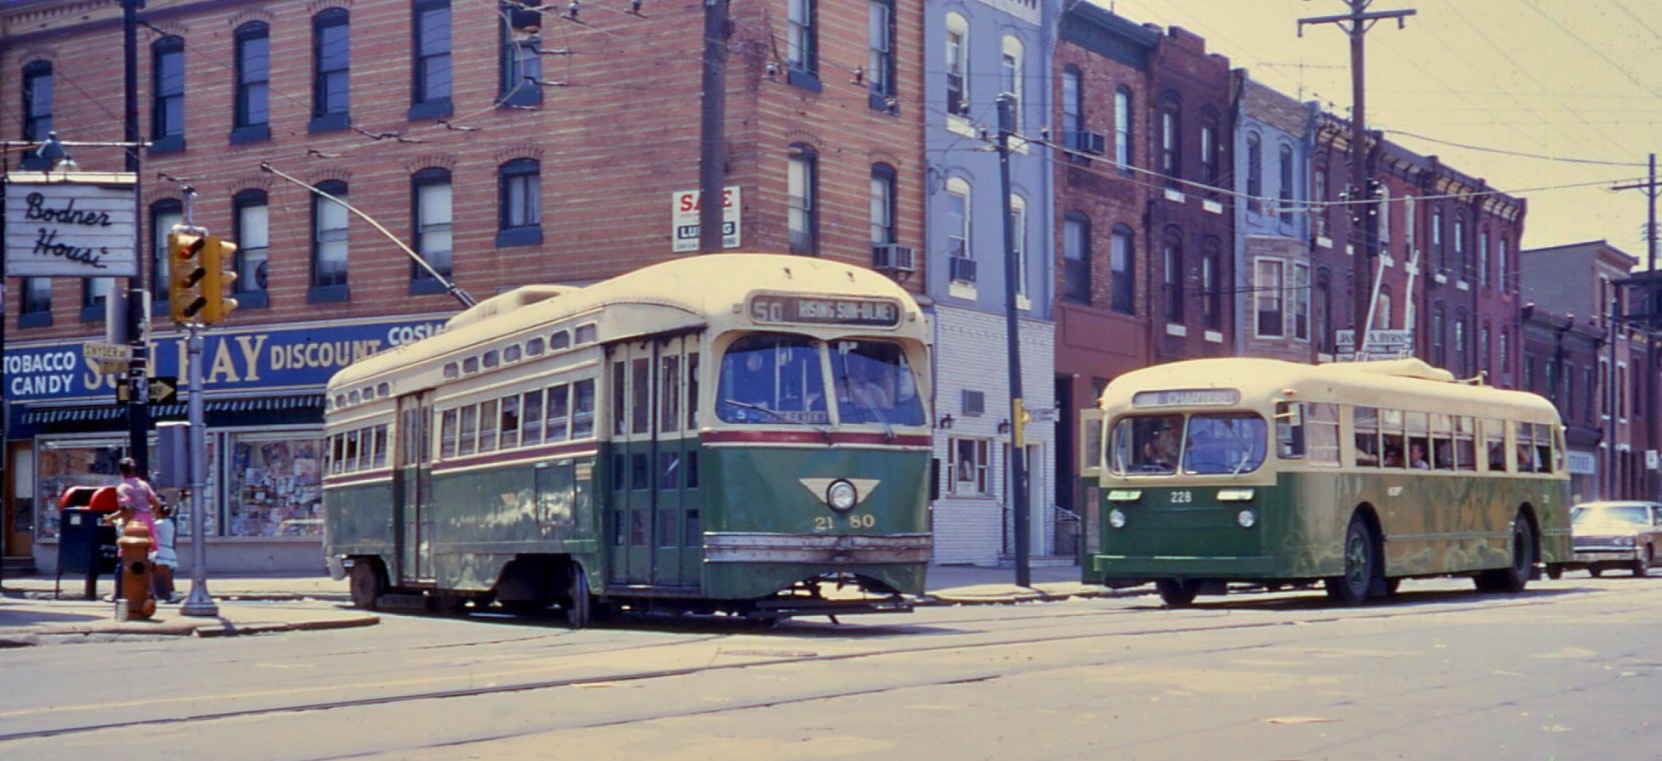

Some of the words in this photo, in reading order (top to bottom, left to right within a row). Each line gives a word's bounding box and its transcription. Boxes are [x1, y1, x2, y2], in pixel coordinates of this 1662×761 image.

[25, 192, 112, 227] Bodner
[753, 302, 783, 322] 50
[799, 300, 835, 318] RISING
[270, 338, 382, 371] DISCOUNT
[11, 374, 75, 396] CANDY
[1170, 491, 1192, 503] 228
